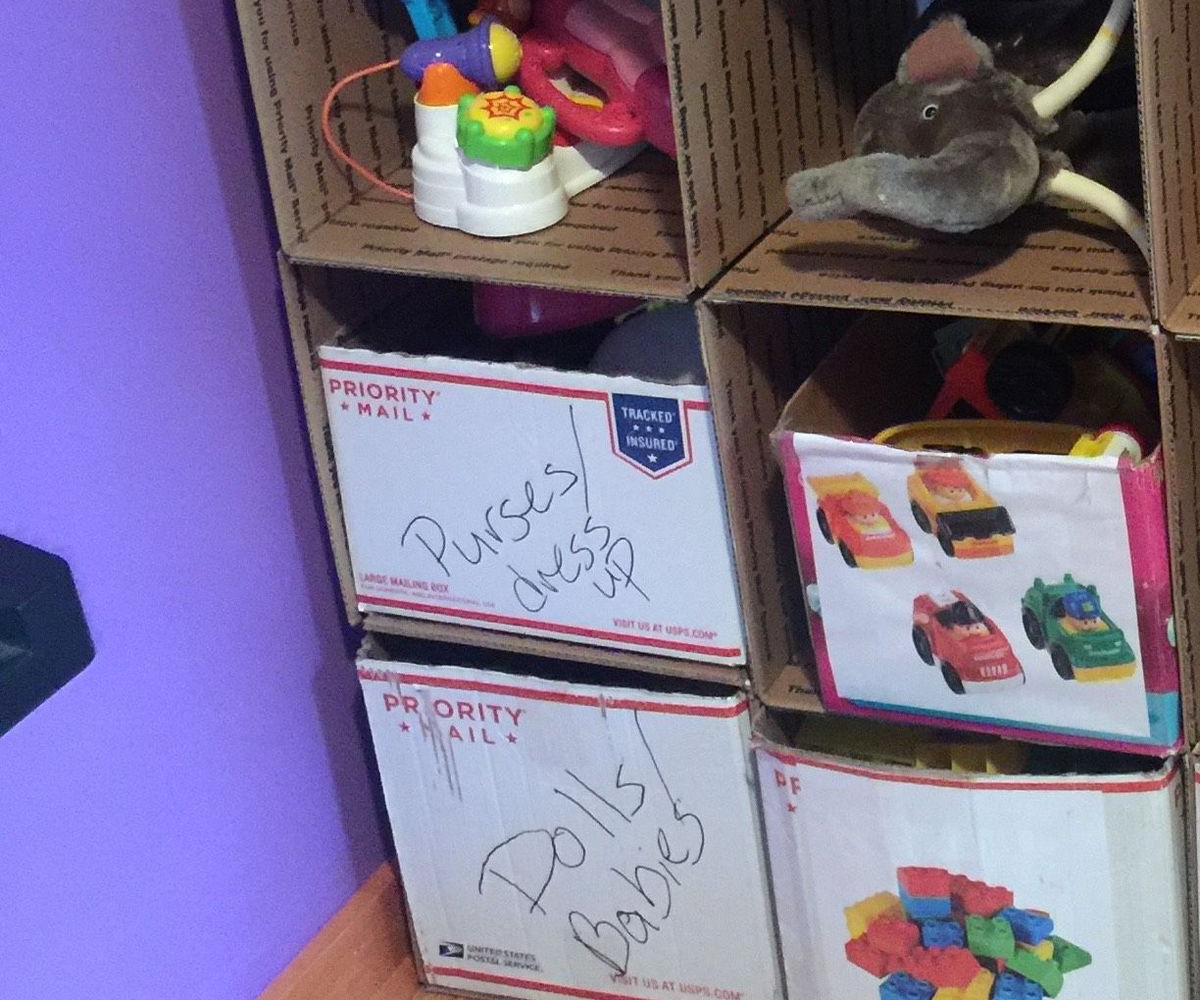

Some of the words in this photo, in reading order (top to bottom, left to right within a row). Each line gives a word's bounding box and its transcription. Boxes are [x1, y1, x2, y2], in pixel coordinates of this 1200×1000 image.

[329, 379, 435, 405] PRIORITY
[357, 402, 413, 421] MAIL
[621, 406, 673, 424] TRACKED
[625, 435, 676, 451] INSURED
[507, 516, 610, 613] dress
[638, 621, 650, 632] US
[383, 693, 522, 727] PRORITY
[569, 799, 704, 977] Babies
